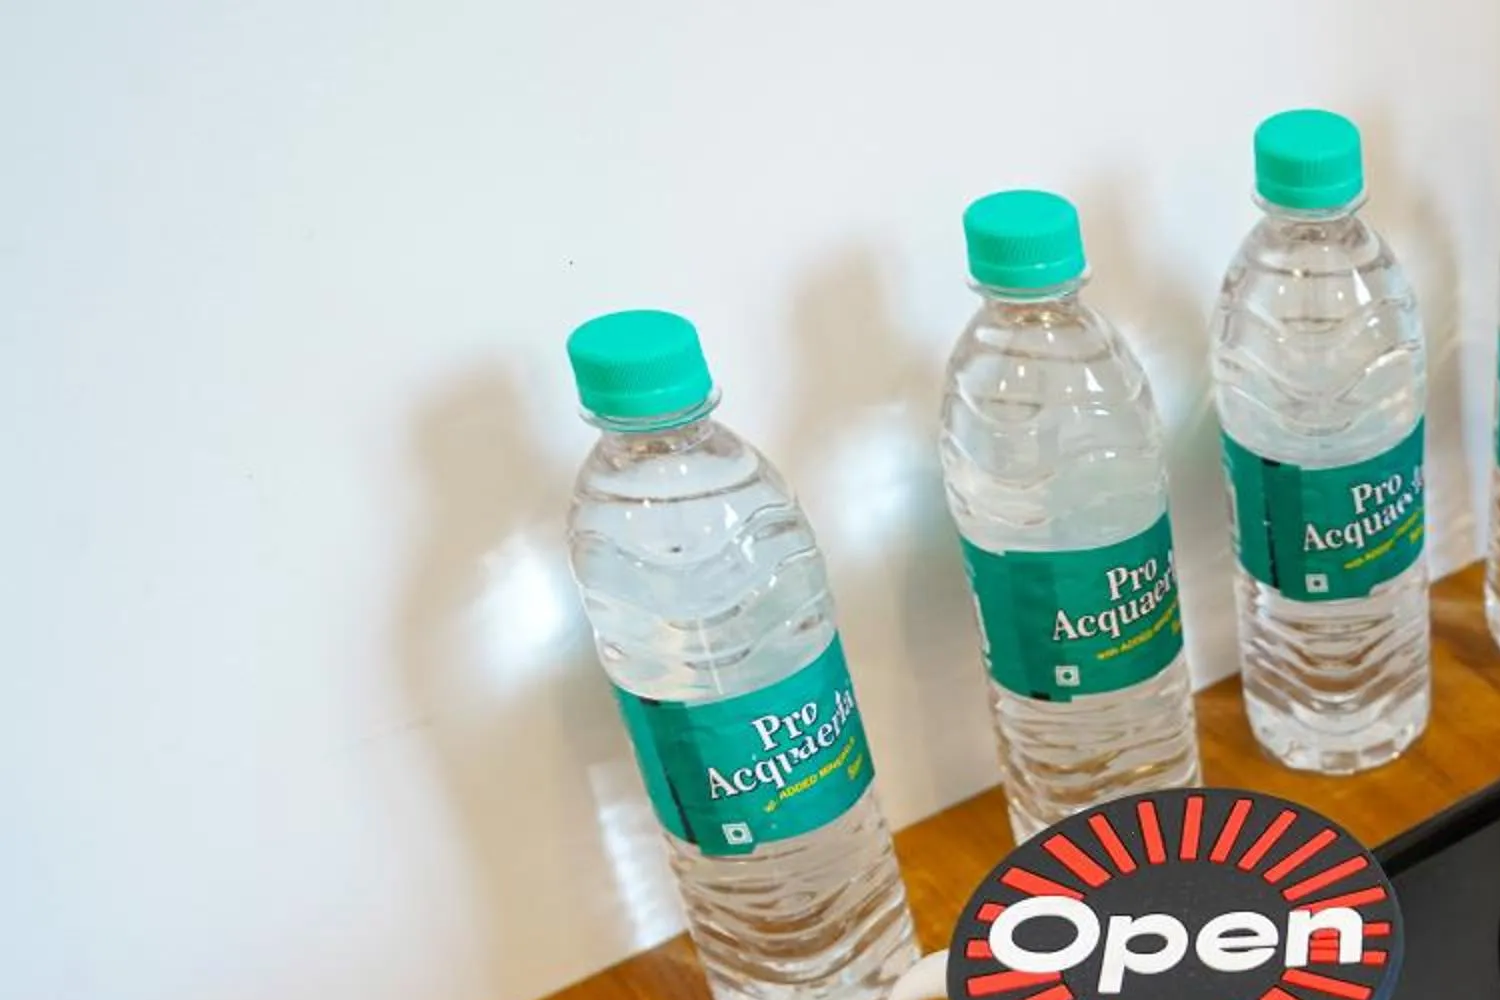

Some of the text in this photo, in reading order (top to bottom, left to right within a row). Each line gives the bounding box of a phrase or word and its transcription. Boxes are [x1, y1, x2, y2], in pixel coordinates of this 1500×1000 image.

[1352, 474, 1402, 515] Pro
[1106, 558, 1157, 601] Pro
[751, 701, 818, 751] Pro
[988, 895, 1364, 994] Open
